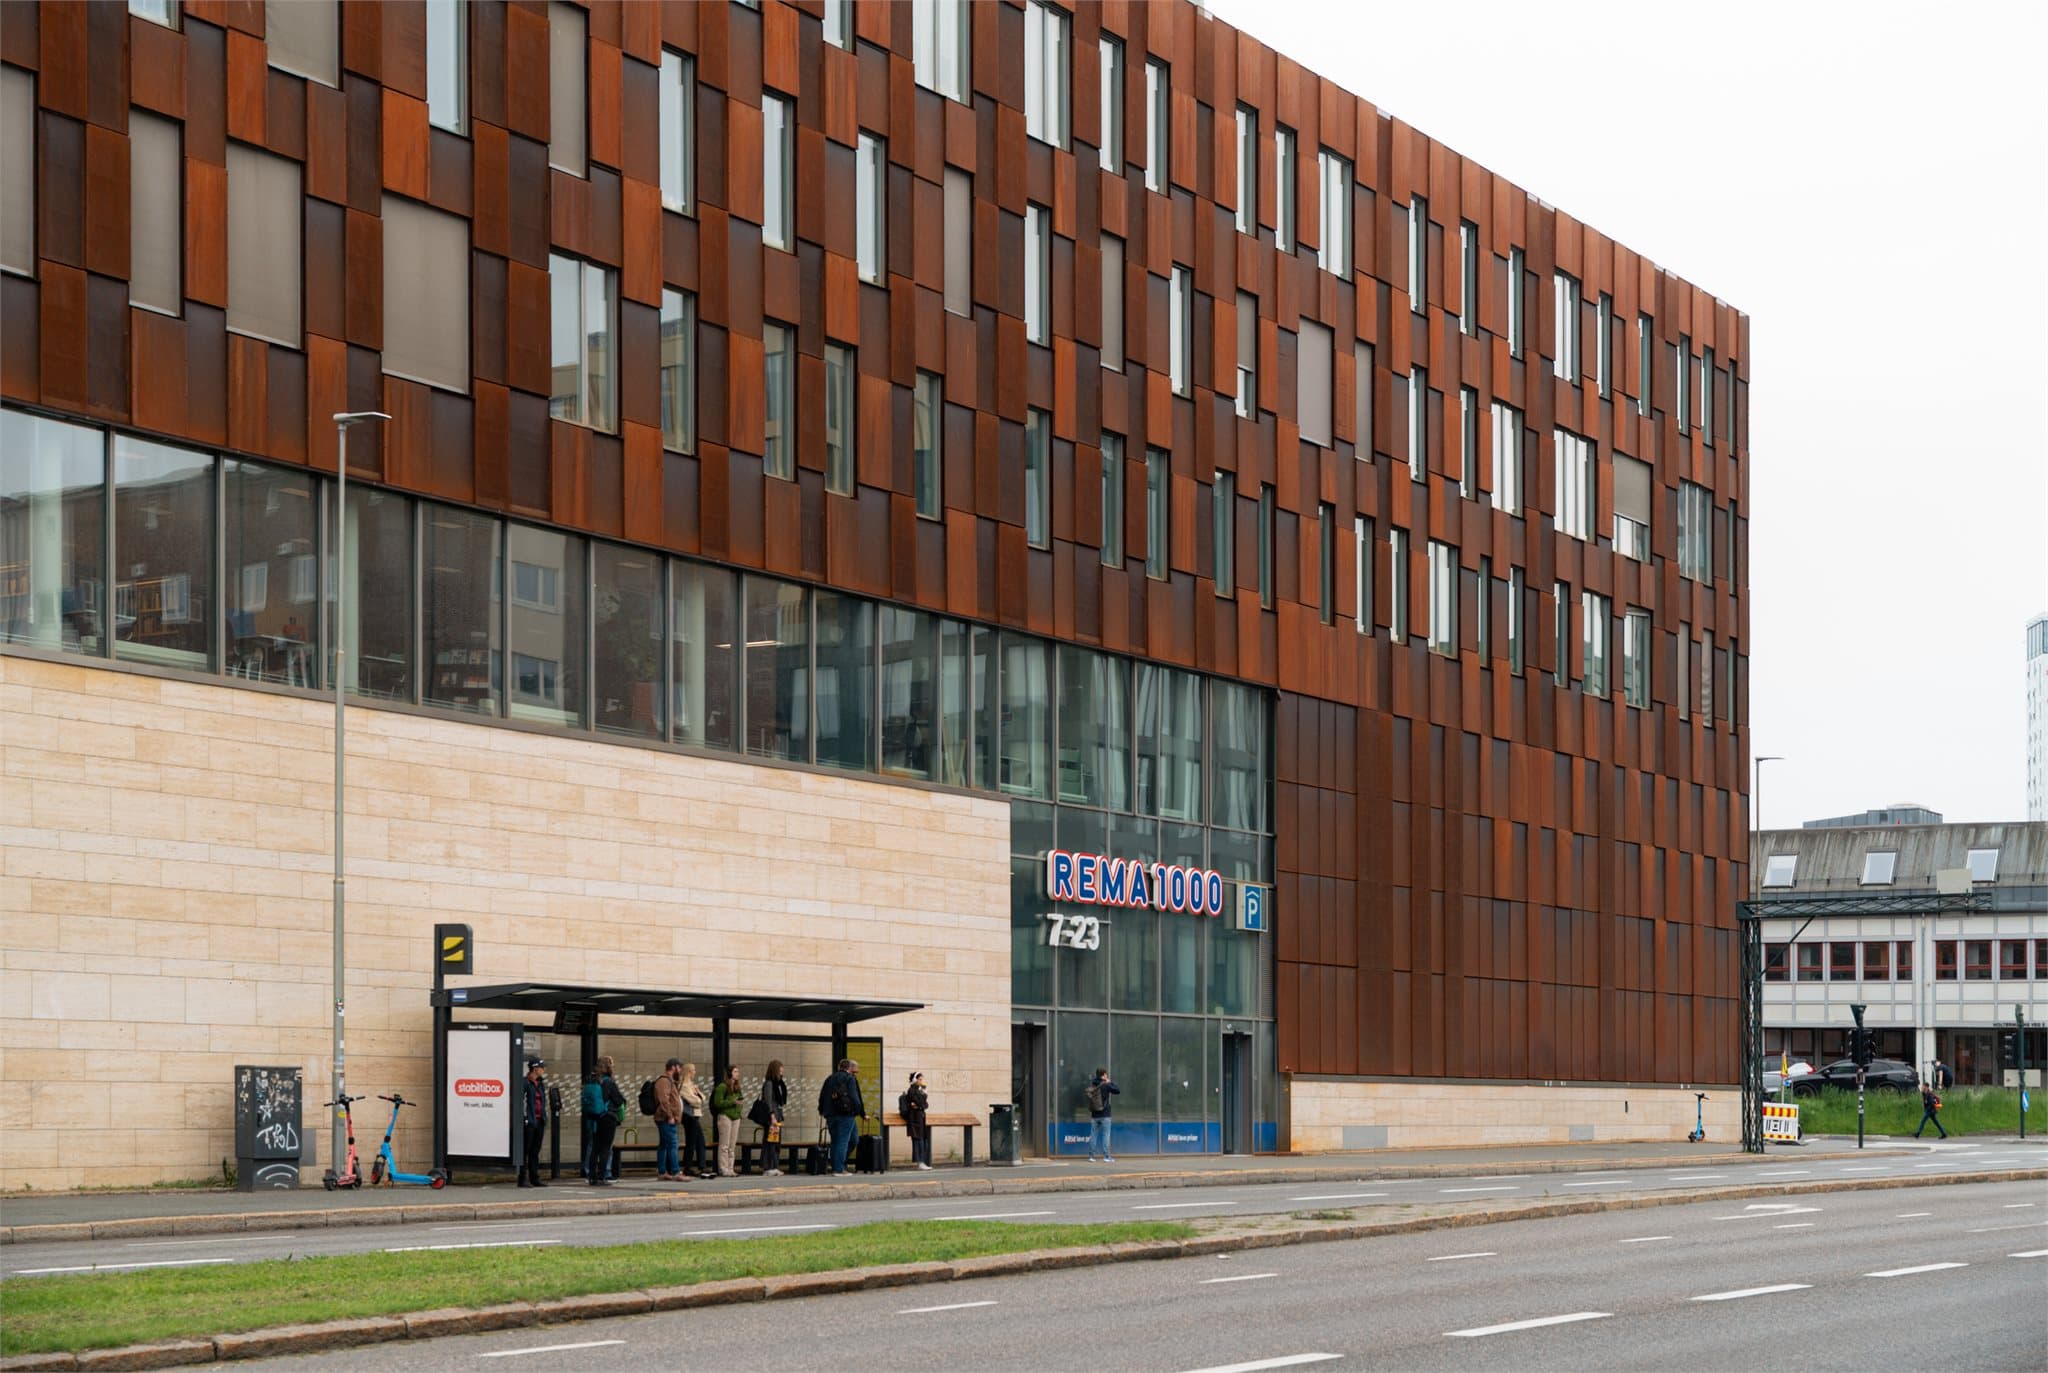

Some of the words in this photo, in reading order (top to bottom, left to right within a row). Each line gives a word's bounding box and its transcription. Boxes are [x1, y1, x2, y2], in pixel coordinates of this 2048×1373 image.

[1048, 850, 1149, 910] REMA
[1151, 863, 1224, 917] 1000
[1047, 913, 1100, 950] 7-23
